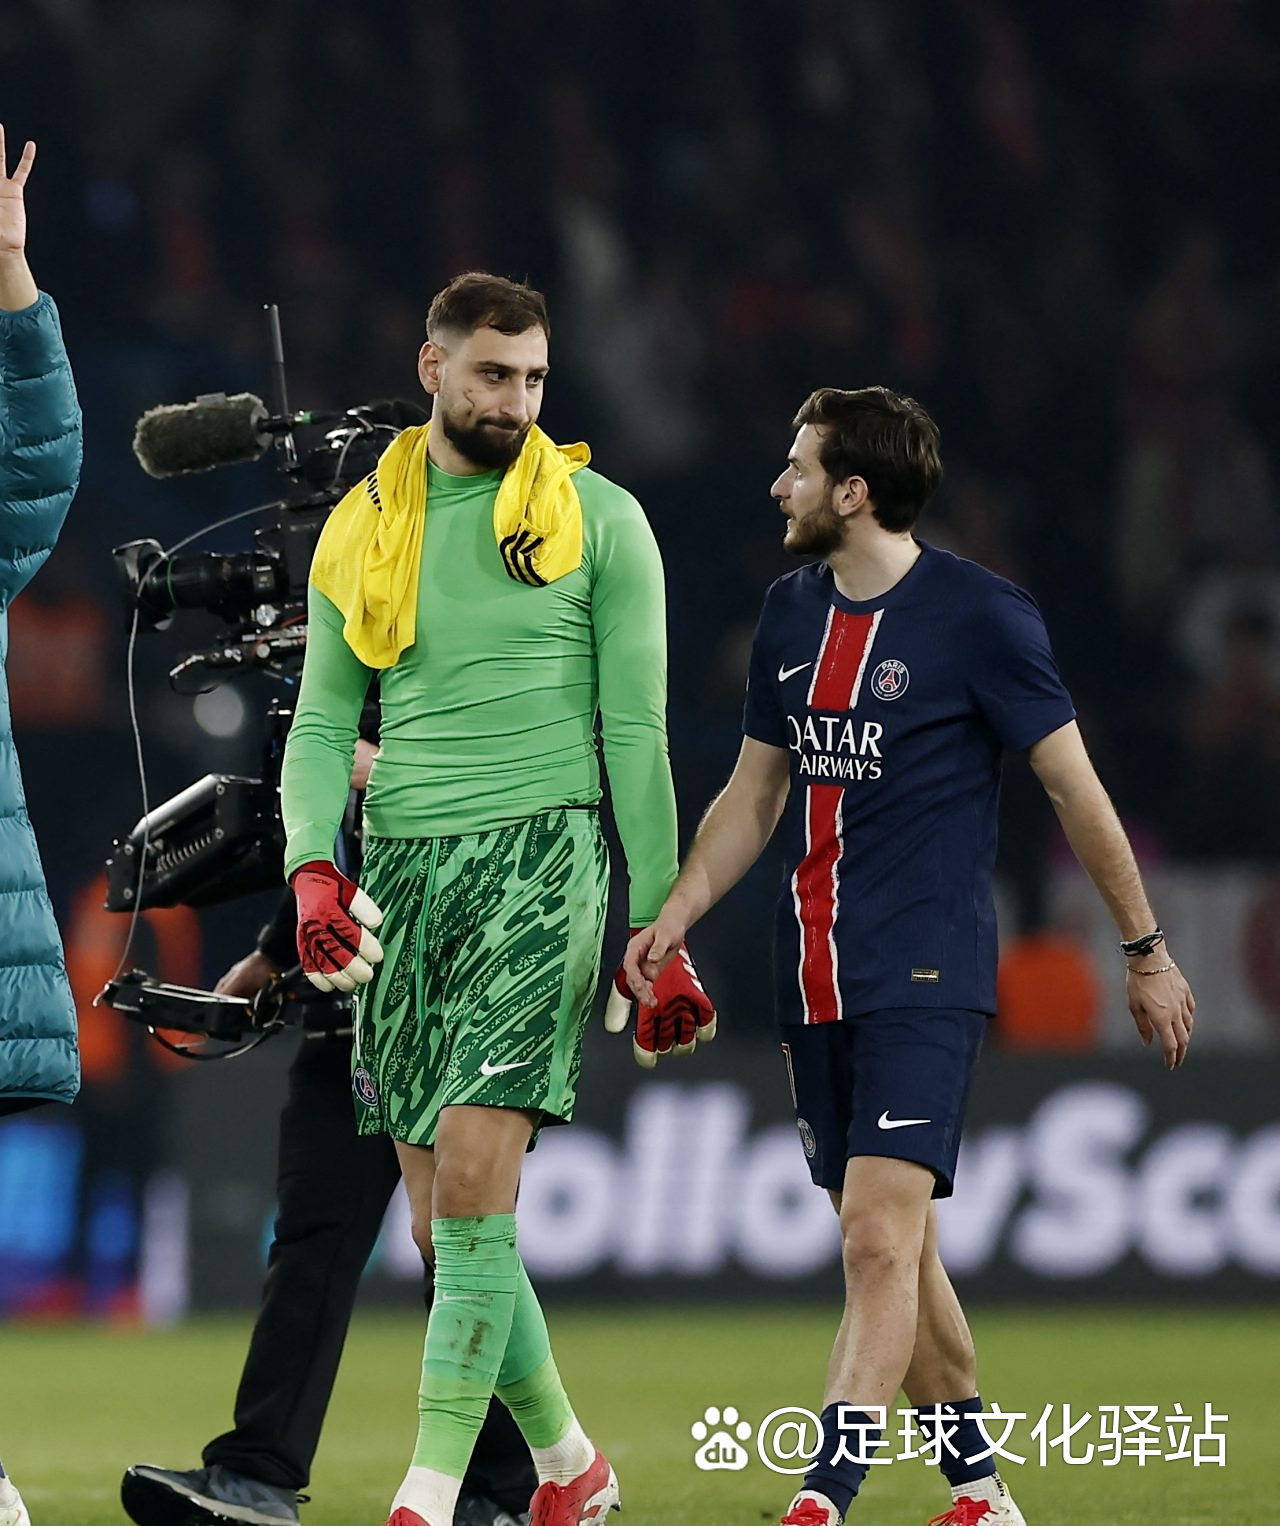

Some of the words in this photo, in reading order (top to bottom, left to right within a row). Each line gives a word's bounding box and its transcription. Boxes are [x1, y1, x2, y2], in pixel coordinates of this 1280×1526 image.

[880, 661, 905, 674] PARIS
[787, 715, 883, 758] QATAR
[799, 754, 883, 780] AIRWAYS
